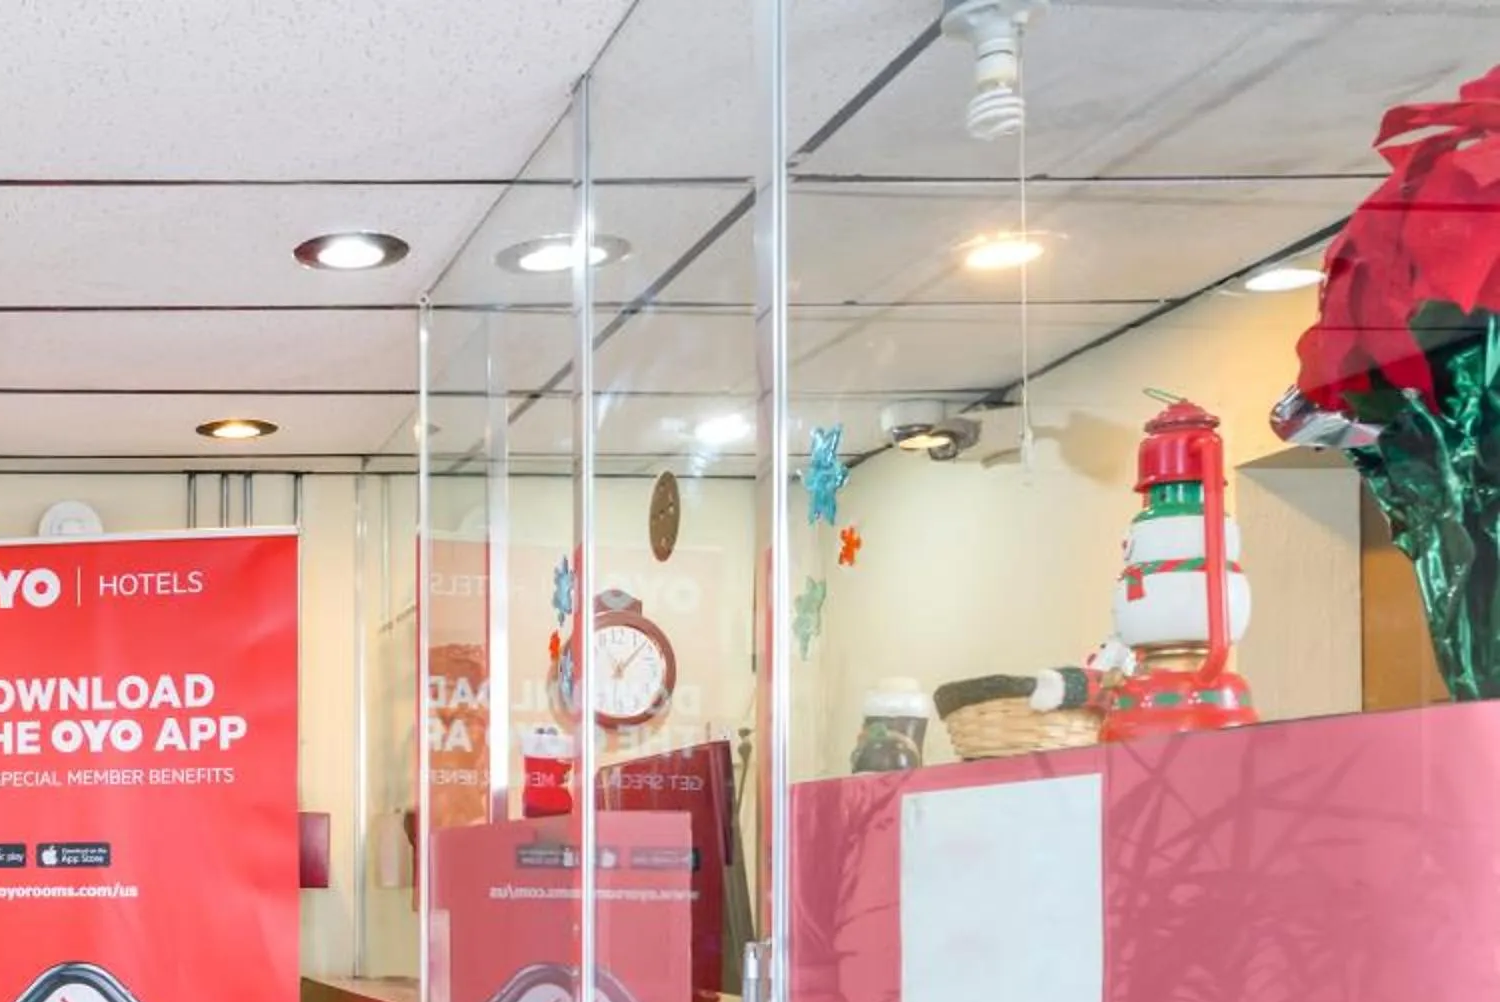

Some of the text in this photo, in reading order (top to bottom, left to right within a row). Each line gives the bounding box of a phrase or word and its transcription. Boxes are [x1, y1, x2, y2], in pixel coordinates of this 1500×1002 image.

[99, 571, 203, 596] HOTELS
[51, 719, 143, 753] OYO
[155, 716, 247, 751] APP
[68, 769, 142, 786] MEMBER
[150, 767, 234, 785] BENEFITS
[61, 854, 104, 864] App Store
